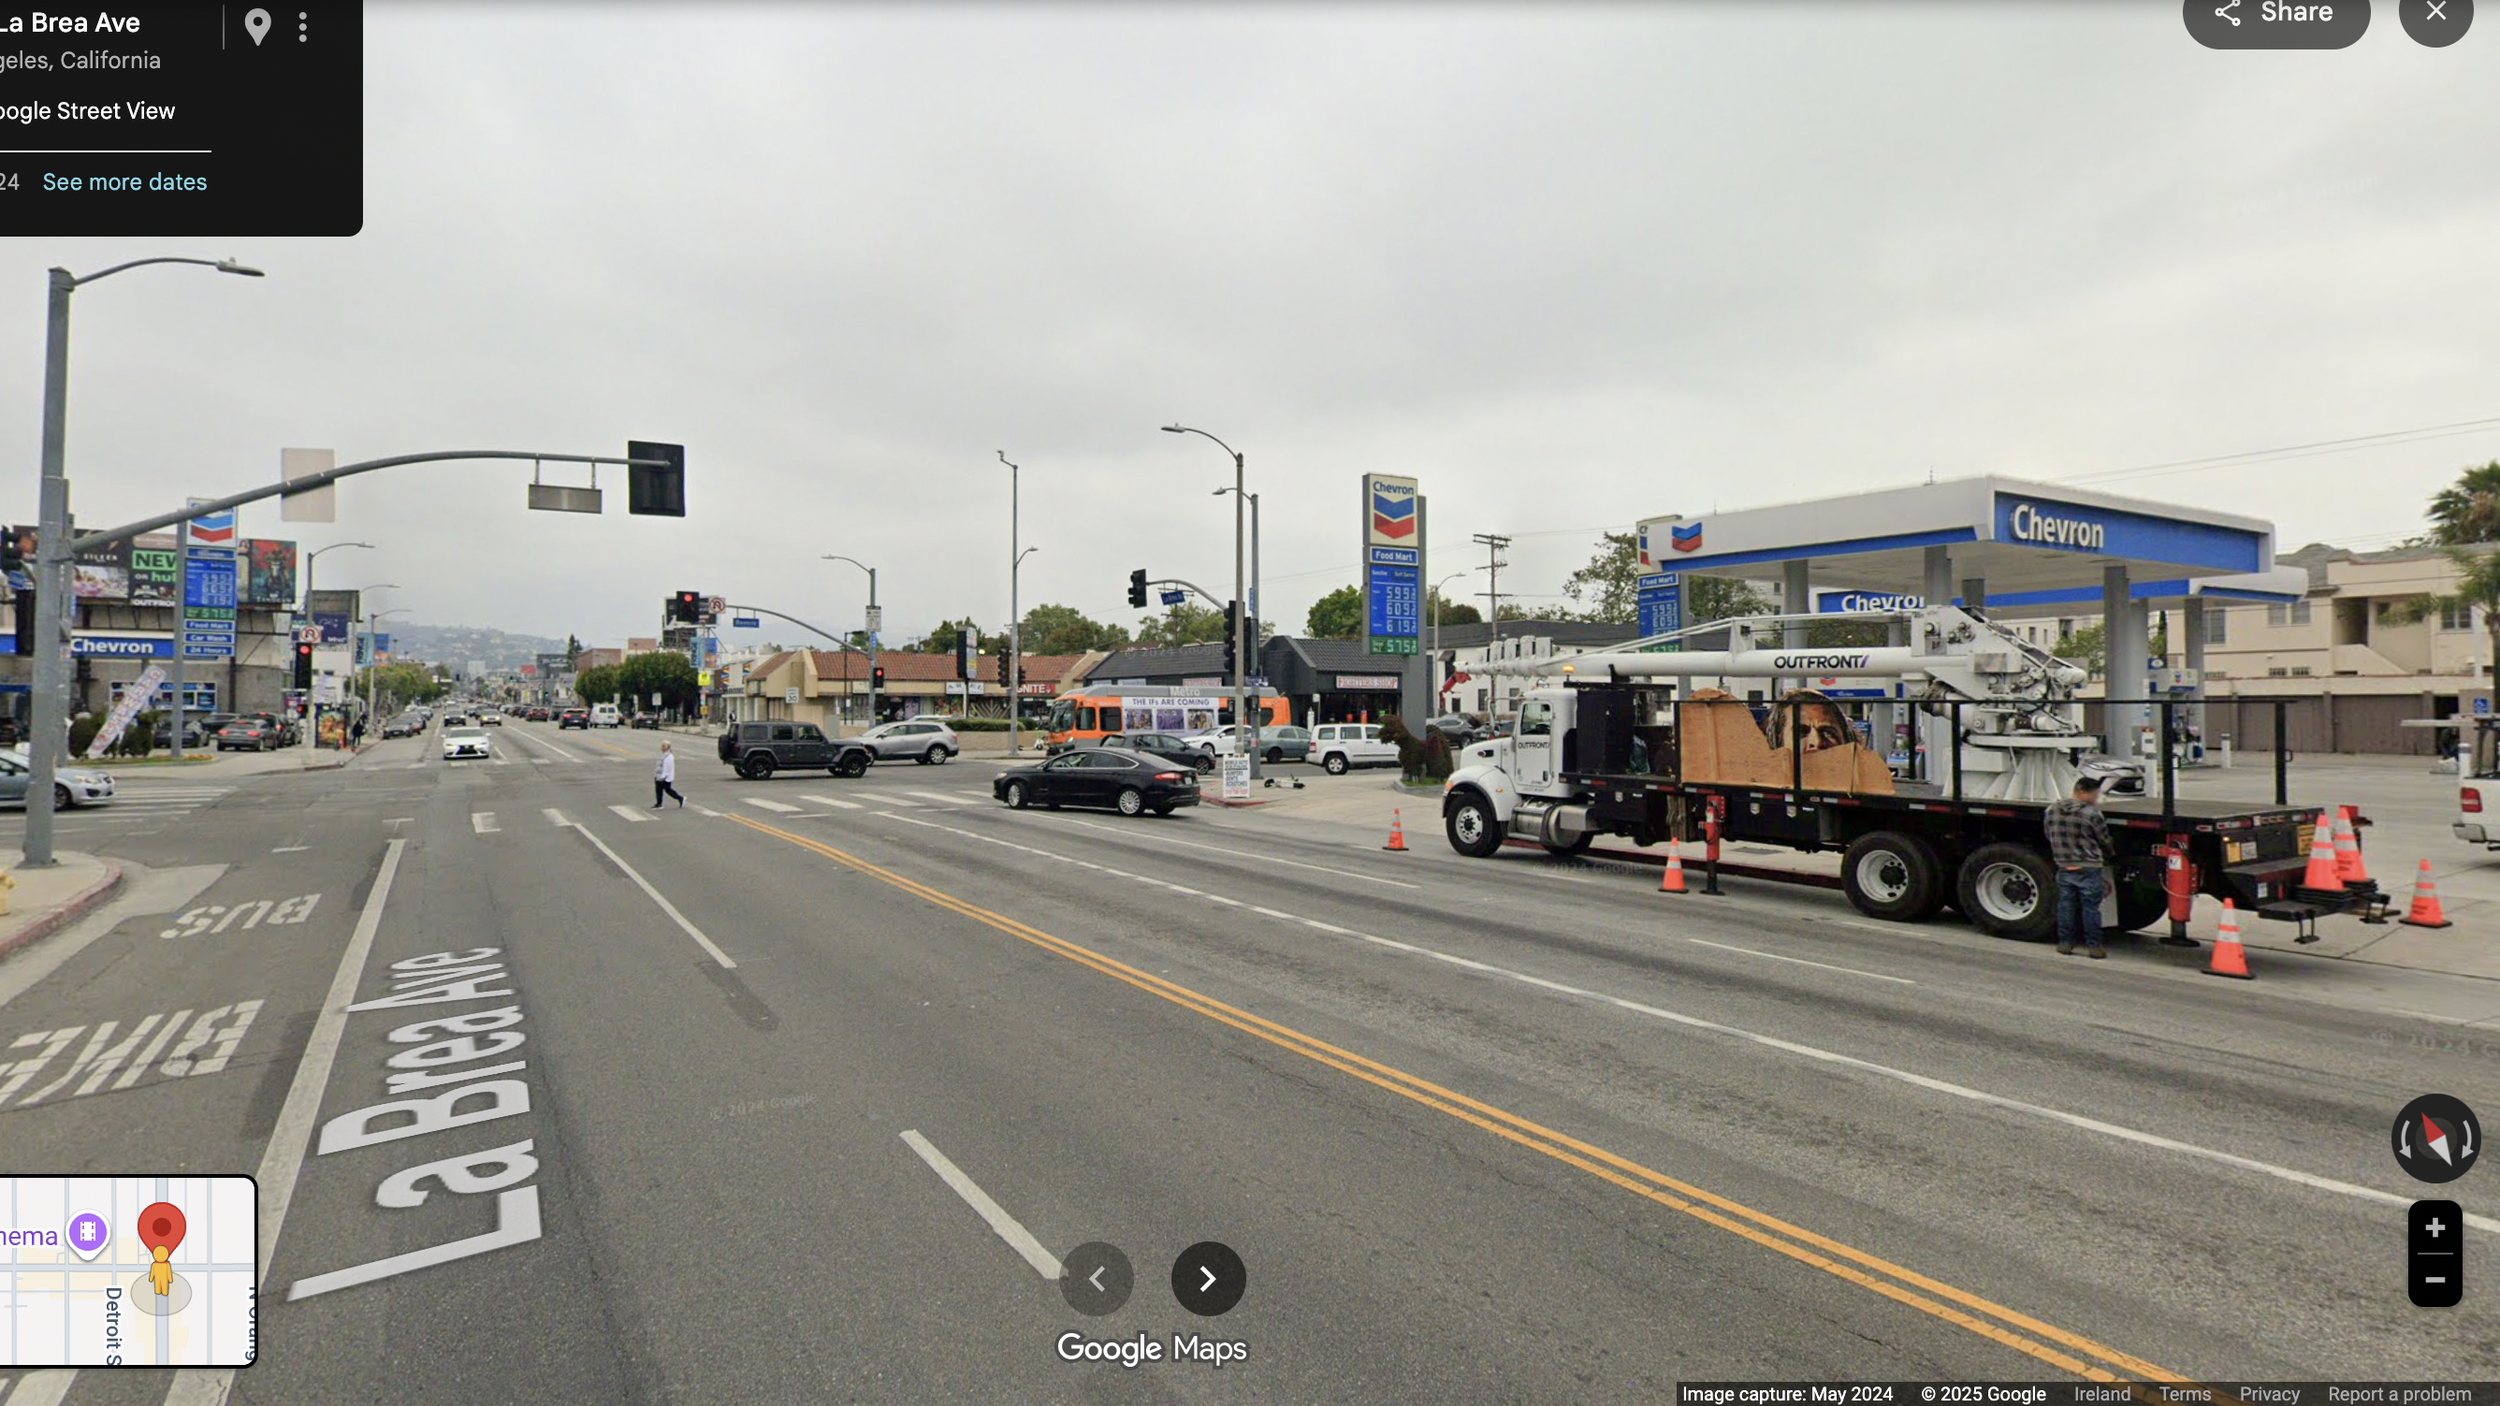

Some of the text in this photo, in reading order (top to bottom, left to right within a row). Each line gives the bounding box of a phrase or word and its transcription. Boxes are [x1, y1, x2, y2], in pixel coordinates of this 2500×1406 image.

[1373, 481, 1414, 495] Chevron
[2014, 504, 2104, 548] Chevron
[1375, 551, 1412, 561] Food Mart
[1642, 577, 1658, 586] Food
[71, 637, 154, 654] Chevron
[1017, 684, 1046, 693] GNITE
[1169, 686, 1200, 697] Metro
[1132, 698, 1146, 706] THE
[1177, 698, 1210, 706] COMING
[160, 894, 322, 939] BUS
[0, 1000, 265, 1107] BIKE
